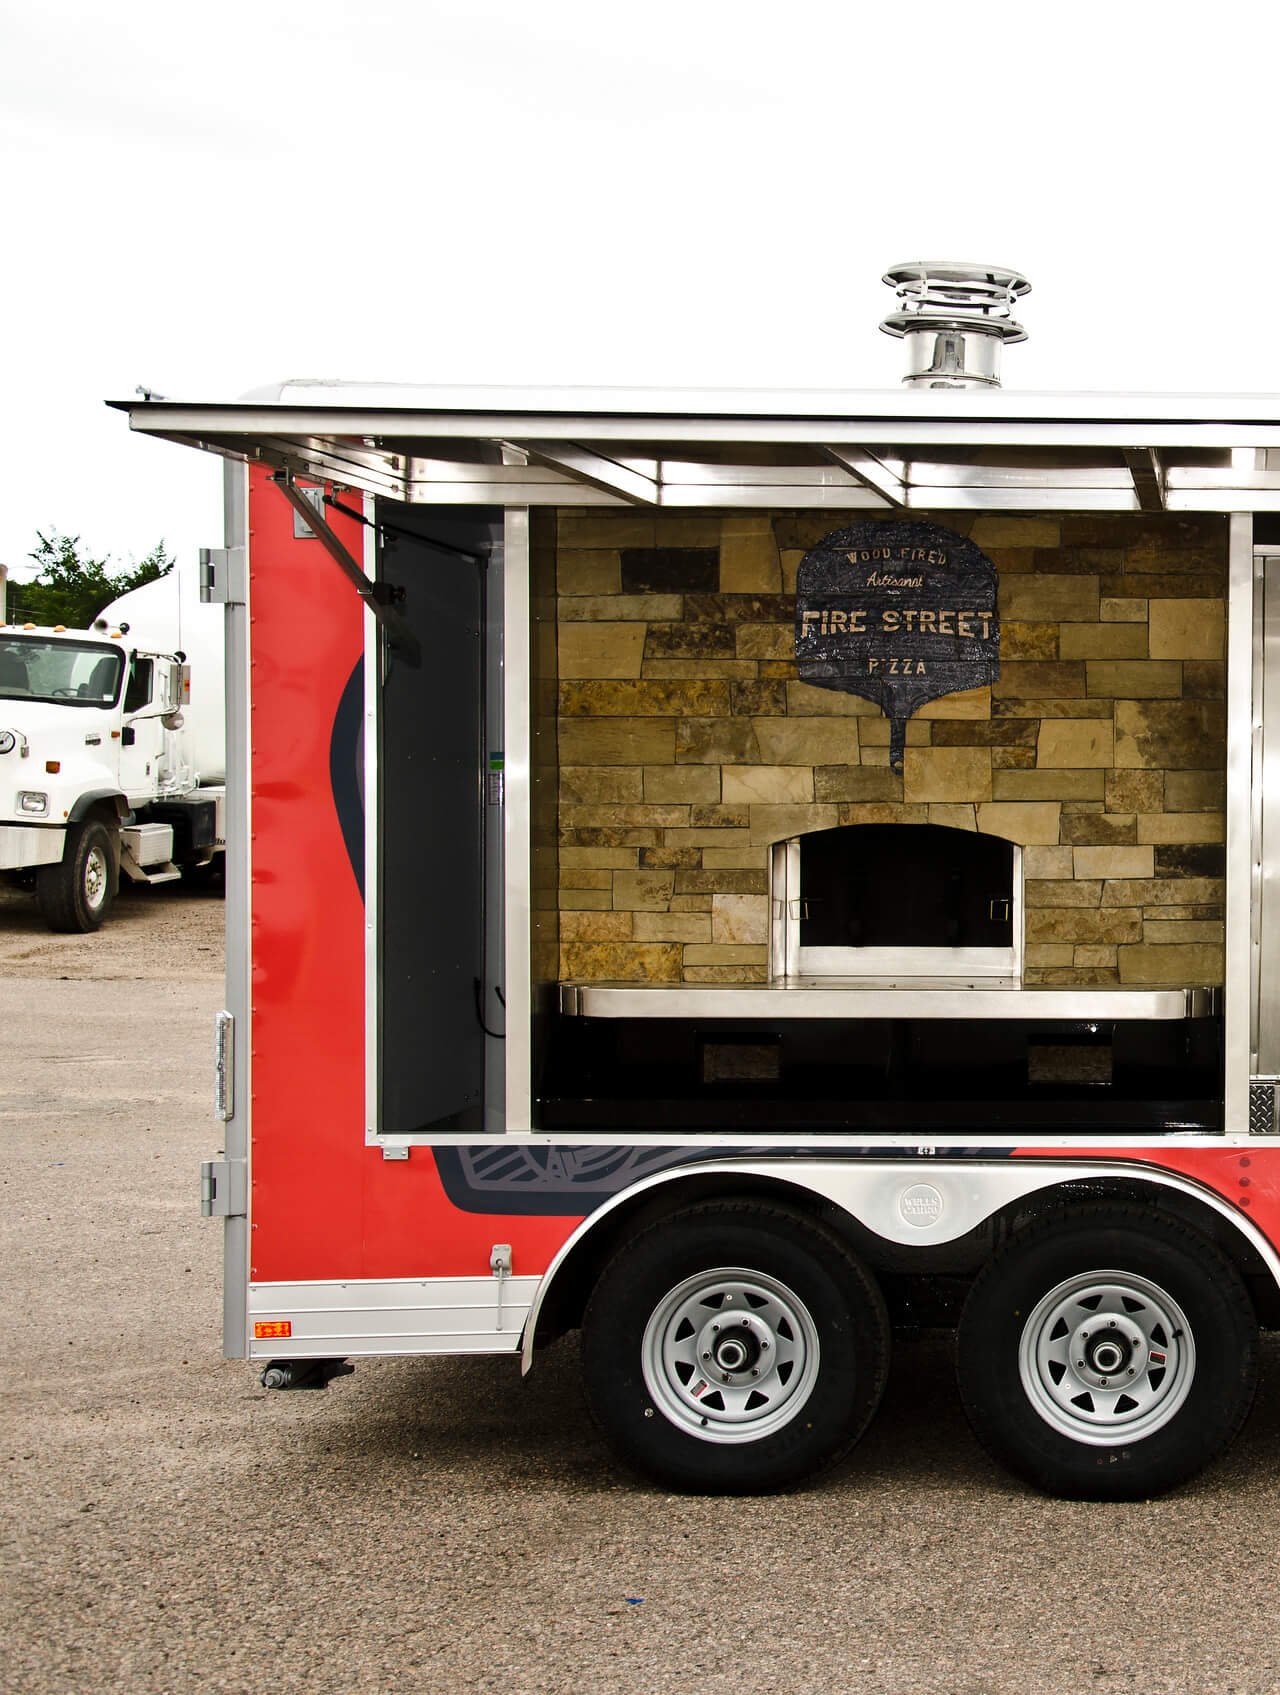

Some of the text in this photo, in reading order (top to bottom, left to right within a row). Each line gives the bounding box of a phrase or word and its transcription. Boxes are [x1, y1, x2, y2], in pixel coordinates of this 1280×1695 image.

[847, 547, 891, 564] WOOD
[866, 570, 924, 588] Artisanal
[882, 610, 993, 640] STREET
